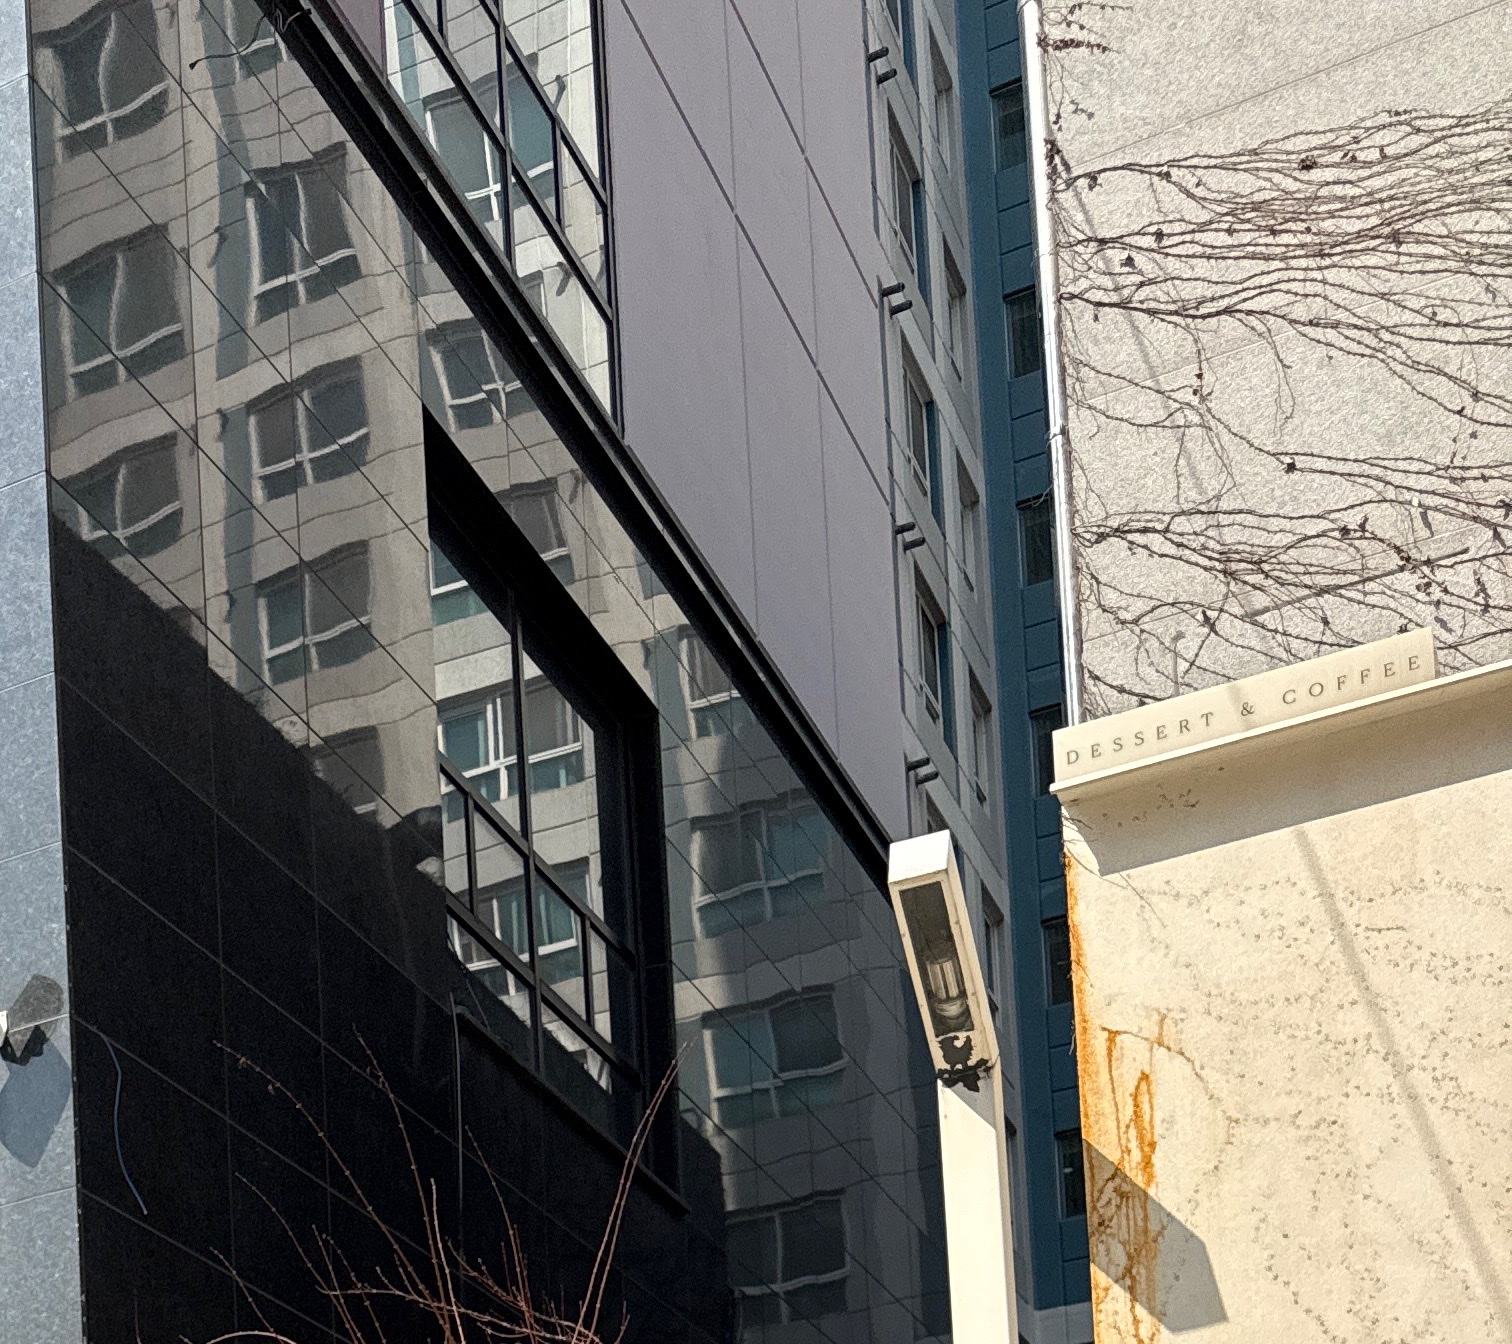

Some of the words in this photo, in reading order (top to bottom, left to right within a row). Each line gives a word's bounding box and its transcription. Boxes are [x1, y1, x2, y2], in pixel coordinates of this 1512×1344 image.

[1066, 712, 1214, 766] DESSERT
[1240, 701, 1255, 717] &
[1282, 655, 1420, 705] COFFEE
